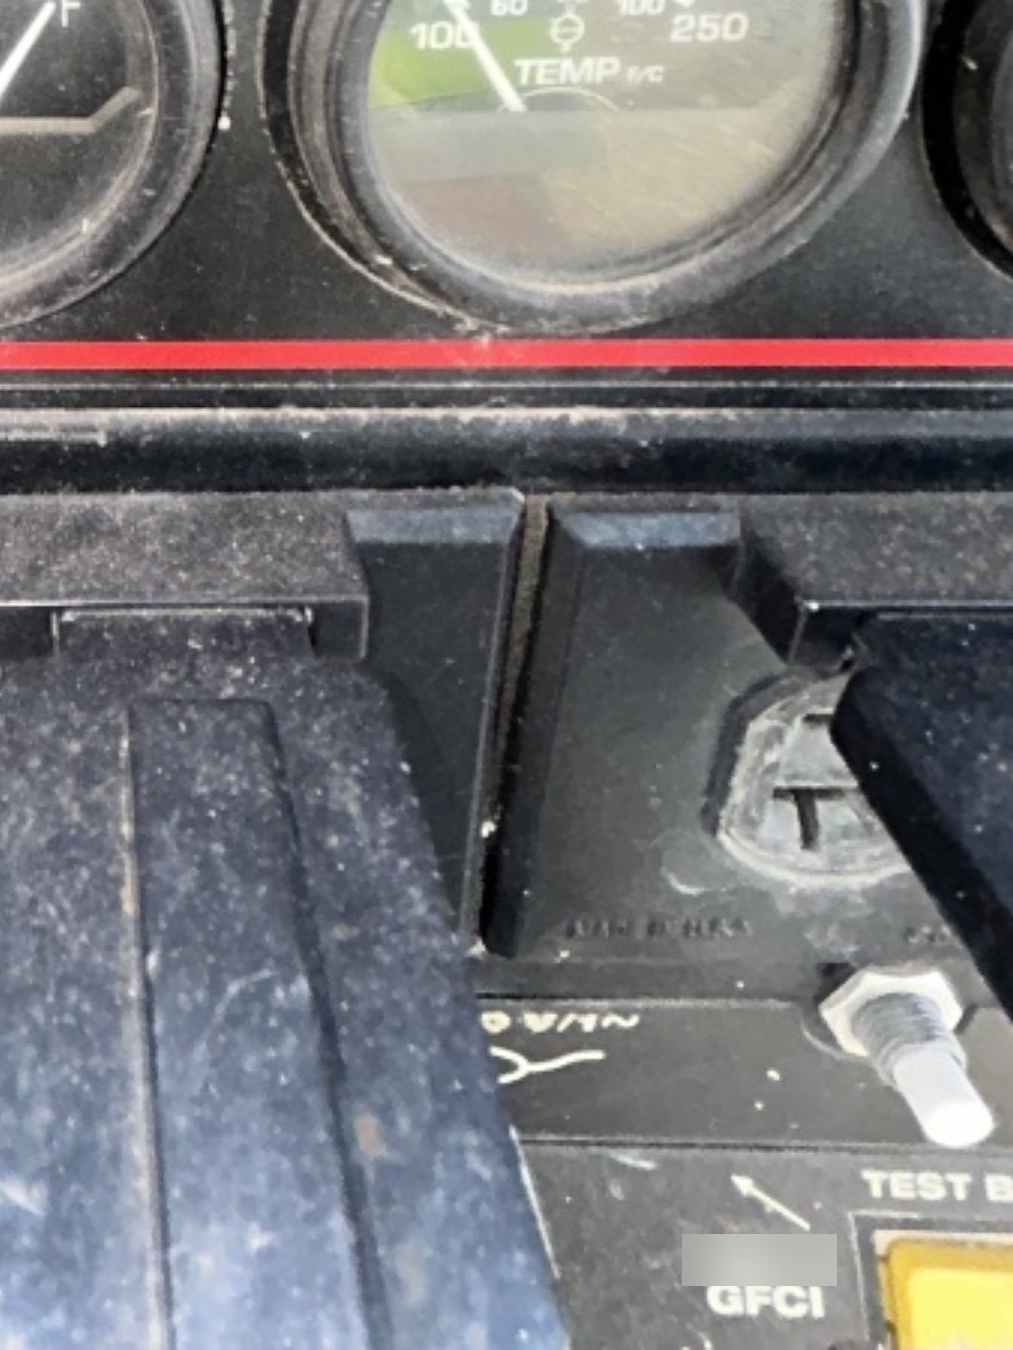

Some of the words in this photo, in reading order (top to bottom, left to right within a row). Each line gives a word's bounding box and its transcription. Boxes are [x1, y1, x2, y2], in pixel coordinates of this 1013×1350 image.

[669, 12, 750, 44] 250
[515, 55, 622, 87] TEMP
[861, 1168, 973, 1201] TEST
[983, 1173, 1013, 1203] B
[707, 1284, 826, 1319] GFCI
